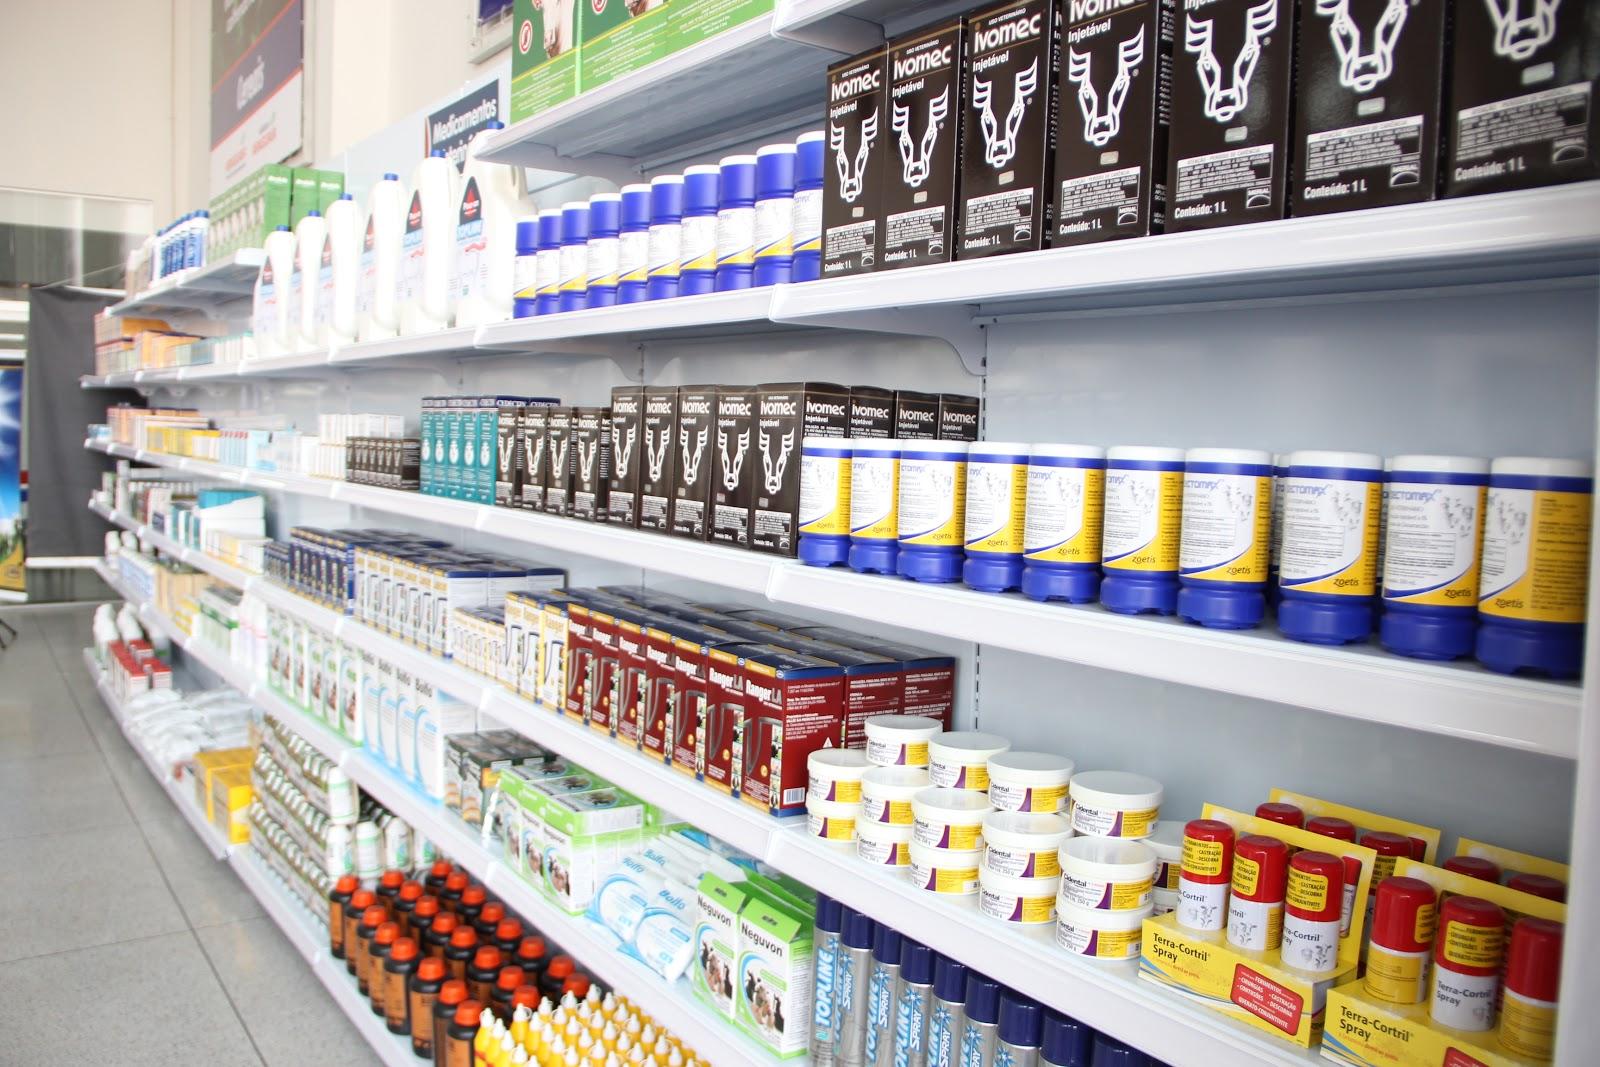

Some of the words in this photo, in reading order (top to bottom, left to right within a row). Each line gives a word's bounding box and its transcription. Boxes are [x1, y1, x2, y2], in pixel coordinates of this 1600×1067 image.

[974, 13, 1041, 53] Ivomec
[1068, 18, 1111, 43] Injetável
[894, 44, 951, 80] Ivomec
[973, 51, 1009, 72] Injetável
[831, 69, 880, 101] Ivomec
[892, 79, 924, 98] Injetável
[830, 101, 857, 118] Injetável
[433, 99, 496, 144] Medicamentos
[1304, 184, 1349, 200] Conteúdo:
[1351, 182, 1358, 193] 1
[1359, 180, 1367, 192] L
[1175, 204, 1213, 219] Conteúdo:
[1213, 202, 1220, 213] 1
[1221, 201, 1227, 212] L
[1060, 221, 1091, 234] Conteúdo:
[613, 402, 637, 413] Ivomec
[647, 402, 671, 413] Ivomec
[682, 401, 710, 414] Ivomec
[718, 402, 751, 416] Ivomec
[761, 401, 796, 415] Ivomec
[806, 400, 845, 415] Ivomec
[852, 403, 889, 418] Ivomec
[900, 407, 934, 422] Ivomec
[943, 410, 976, 424] Ivomec
[932, 532, 952, 540] zoetis
[987, 538, 1008, 547] zoetis
[1058, 546, 1081, 556] zoetis
[1132, 554, 1156, 565] zoetis
[1226, 565, 1251, 576] zoetis
[1333, 577, 1359, 588] zoetis
[1444, 587, 1471, 599] zoetis
[1495, 597, 1524, 609] zoetis
[675, 655, 697, 676] Ranger
[709, 667, 733, 688] Ranger
[733, 674, 743, 690] LA
[746, 679, 771, 702] Ranger
[771, 688, 782, 704] LA
[1076, 803, 1098, 815] Cidental
[989, 846, 1011, 858] Cidental
[1064, 873, 1087, 887] Cidental
[1300, 881, 1325, 890] CASTRAÇÃO
[659, 889, 687, 910] Bolfo
[697, 894, 732, 927] Neguvon
[741, 922, 783, 957] Neguvon
[1153, 932, 1207, 962] Terra-Cortril
[1153, 944, 1177, 963] Spray
[815, 948, 834, 1027] TOPLINE
[842, 973, 853, 1010] SPRAY
[1255, 976, 1282, 994] FERIMENTOS
[1438, 980, 1492, 998] Terra-Cortril
[1271, 993, 1296, 1010] CASTRAÇÃO
[1437, 990, 1460, 1007] Spray
[879, 990, 890, 1028] SPRAY
[1269, 1001, 1293, 1017] DESCORNA
[910, 1010, 922, 1051] SPRAY
[1340, 1018, 1371, 1042] Spray
[1341, 1005, 1409, 1042] Terra-Cortril
[895, 999, 911, 1067] OPLINE
